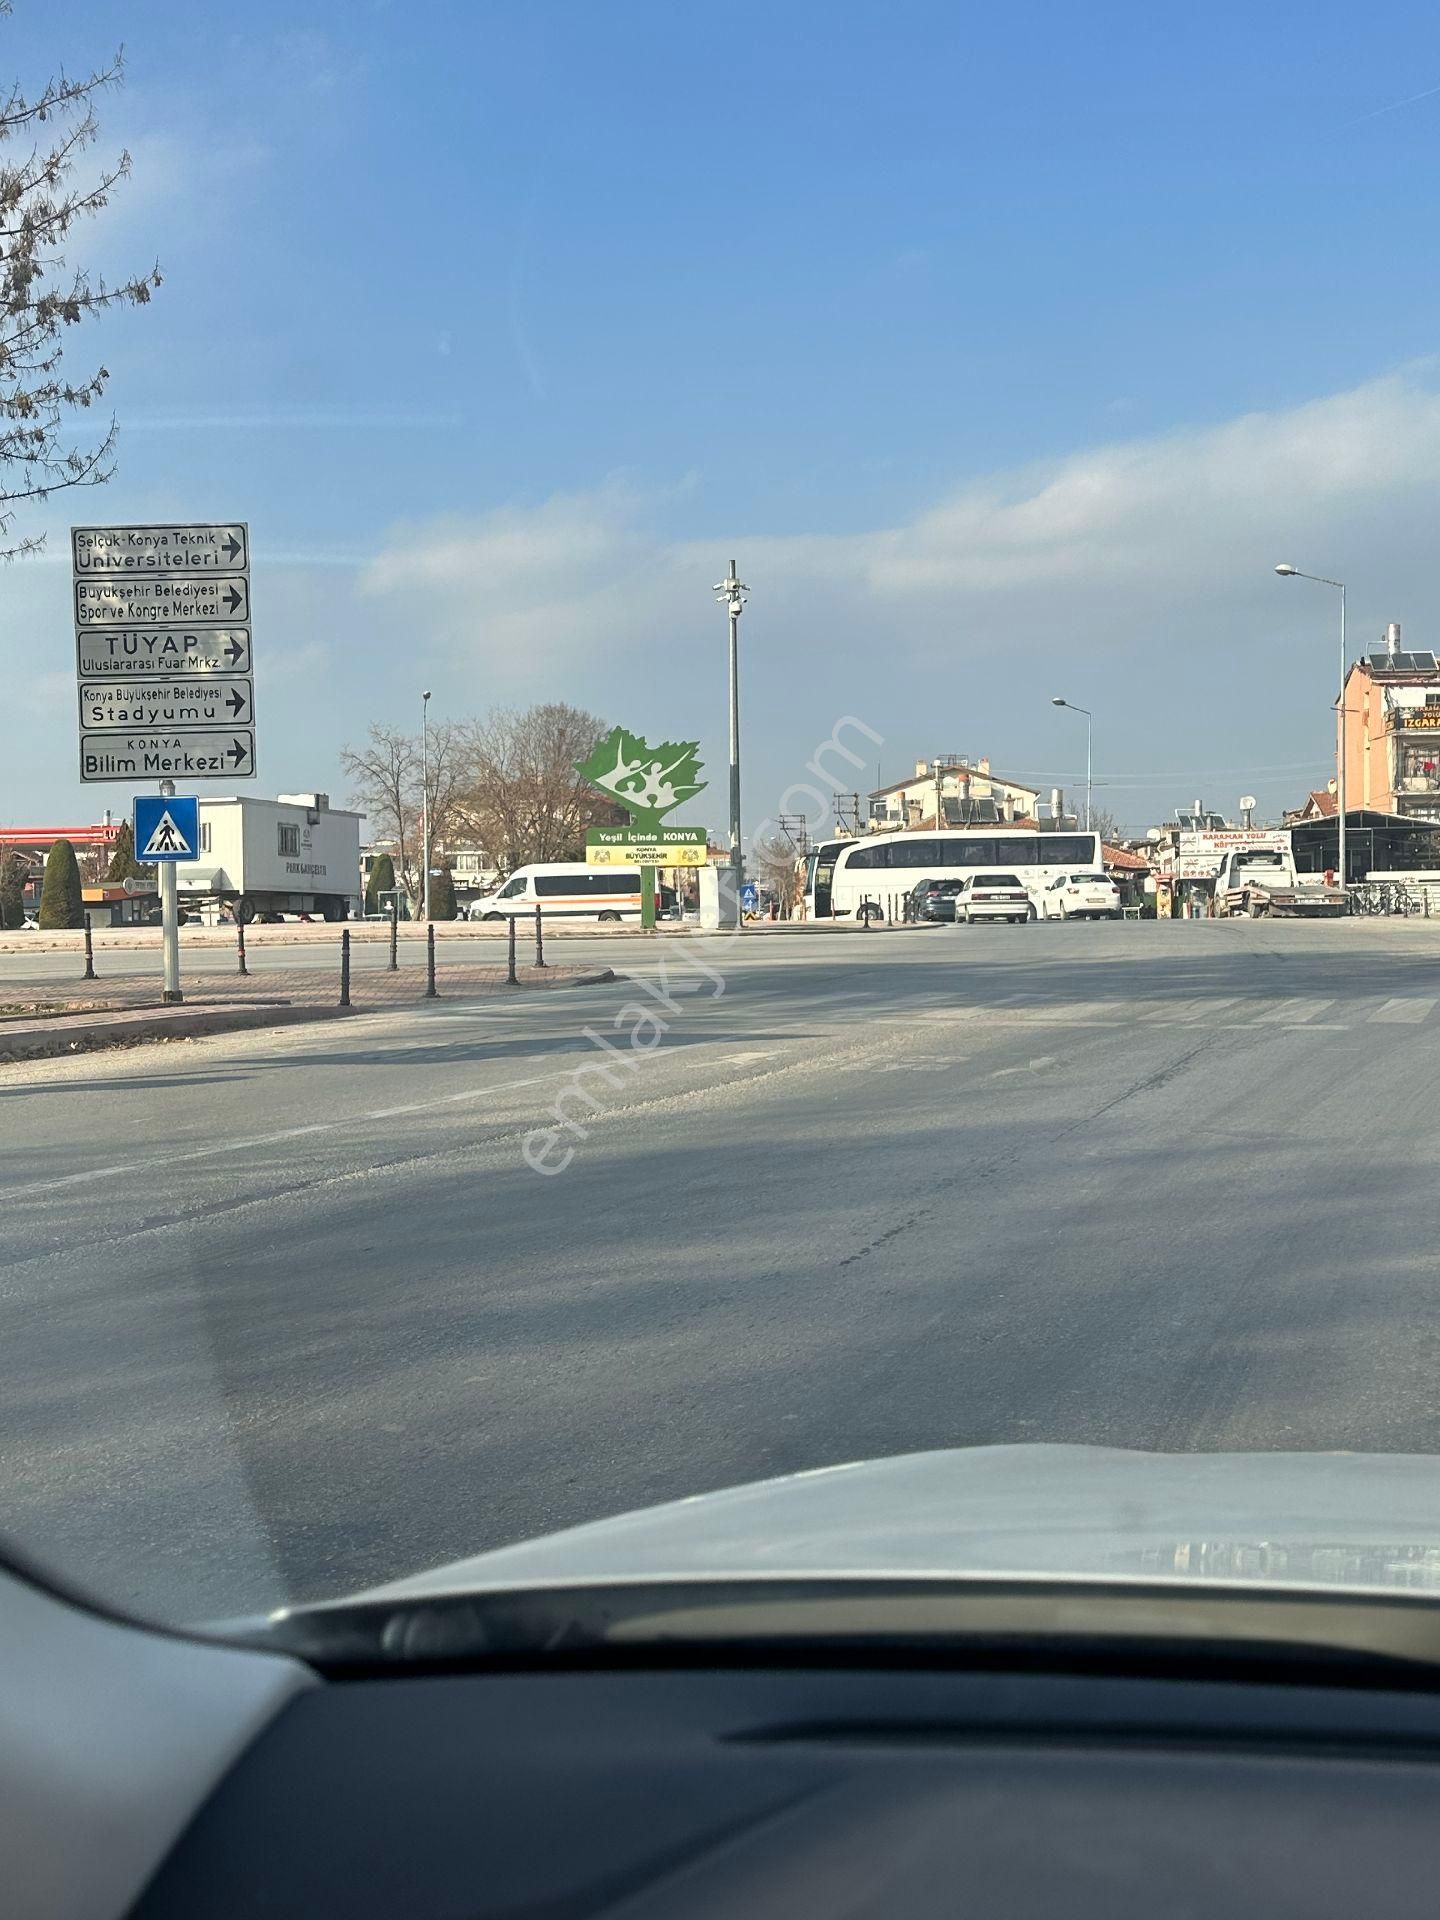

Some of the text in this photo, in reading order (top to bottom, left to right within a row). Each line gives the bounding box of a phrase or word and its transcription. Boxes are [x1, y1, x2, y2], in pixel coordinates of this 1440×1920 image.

[79, 549, 219, 568] Üniversiteleri
[155, 583, 219, 599] Belediyesi
[79, 600, 219, 622] Spor ve Kongre Merkezi
[105, 633, 198, 655] TÜYAP
[82, 658, 155, 671] Uluslararası
[158, 656, 186, 669] Fuar
[83, 687, 222, 704] Konya Büyükşehir Belediyesi
[92, 705, 216, 724] Stadyumu
[127, 739, 182, 750] KONYA
[85, 752, 225, 773] Bilim Merkezi
[599, 831, 698, 843] Yeşil İçinde KONYA
